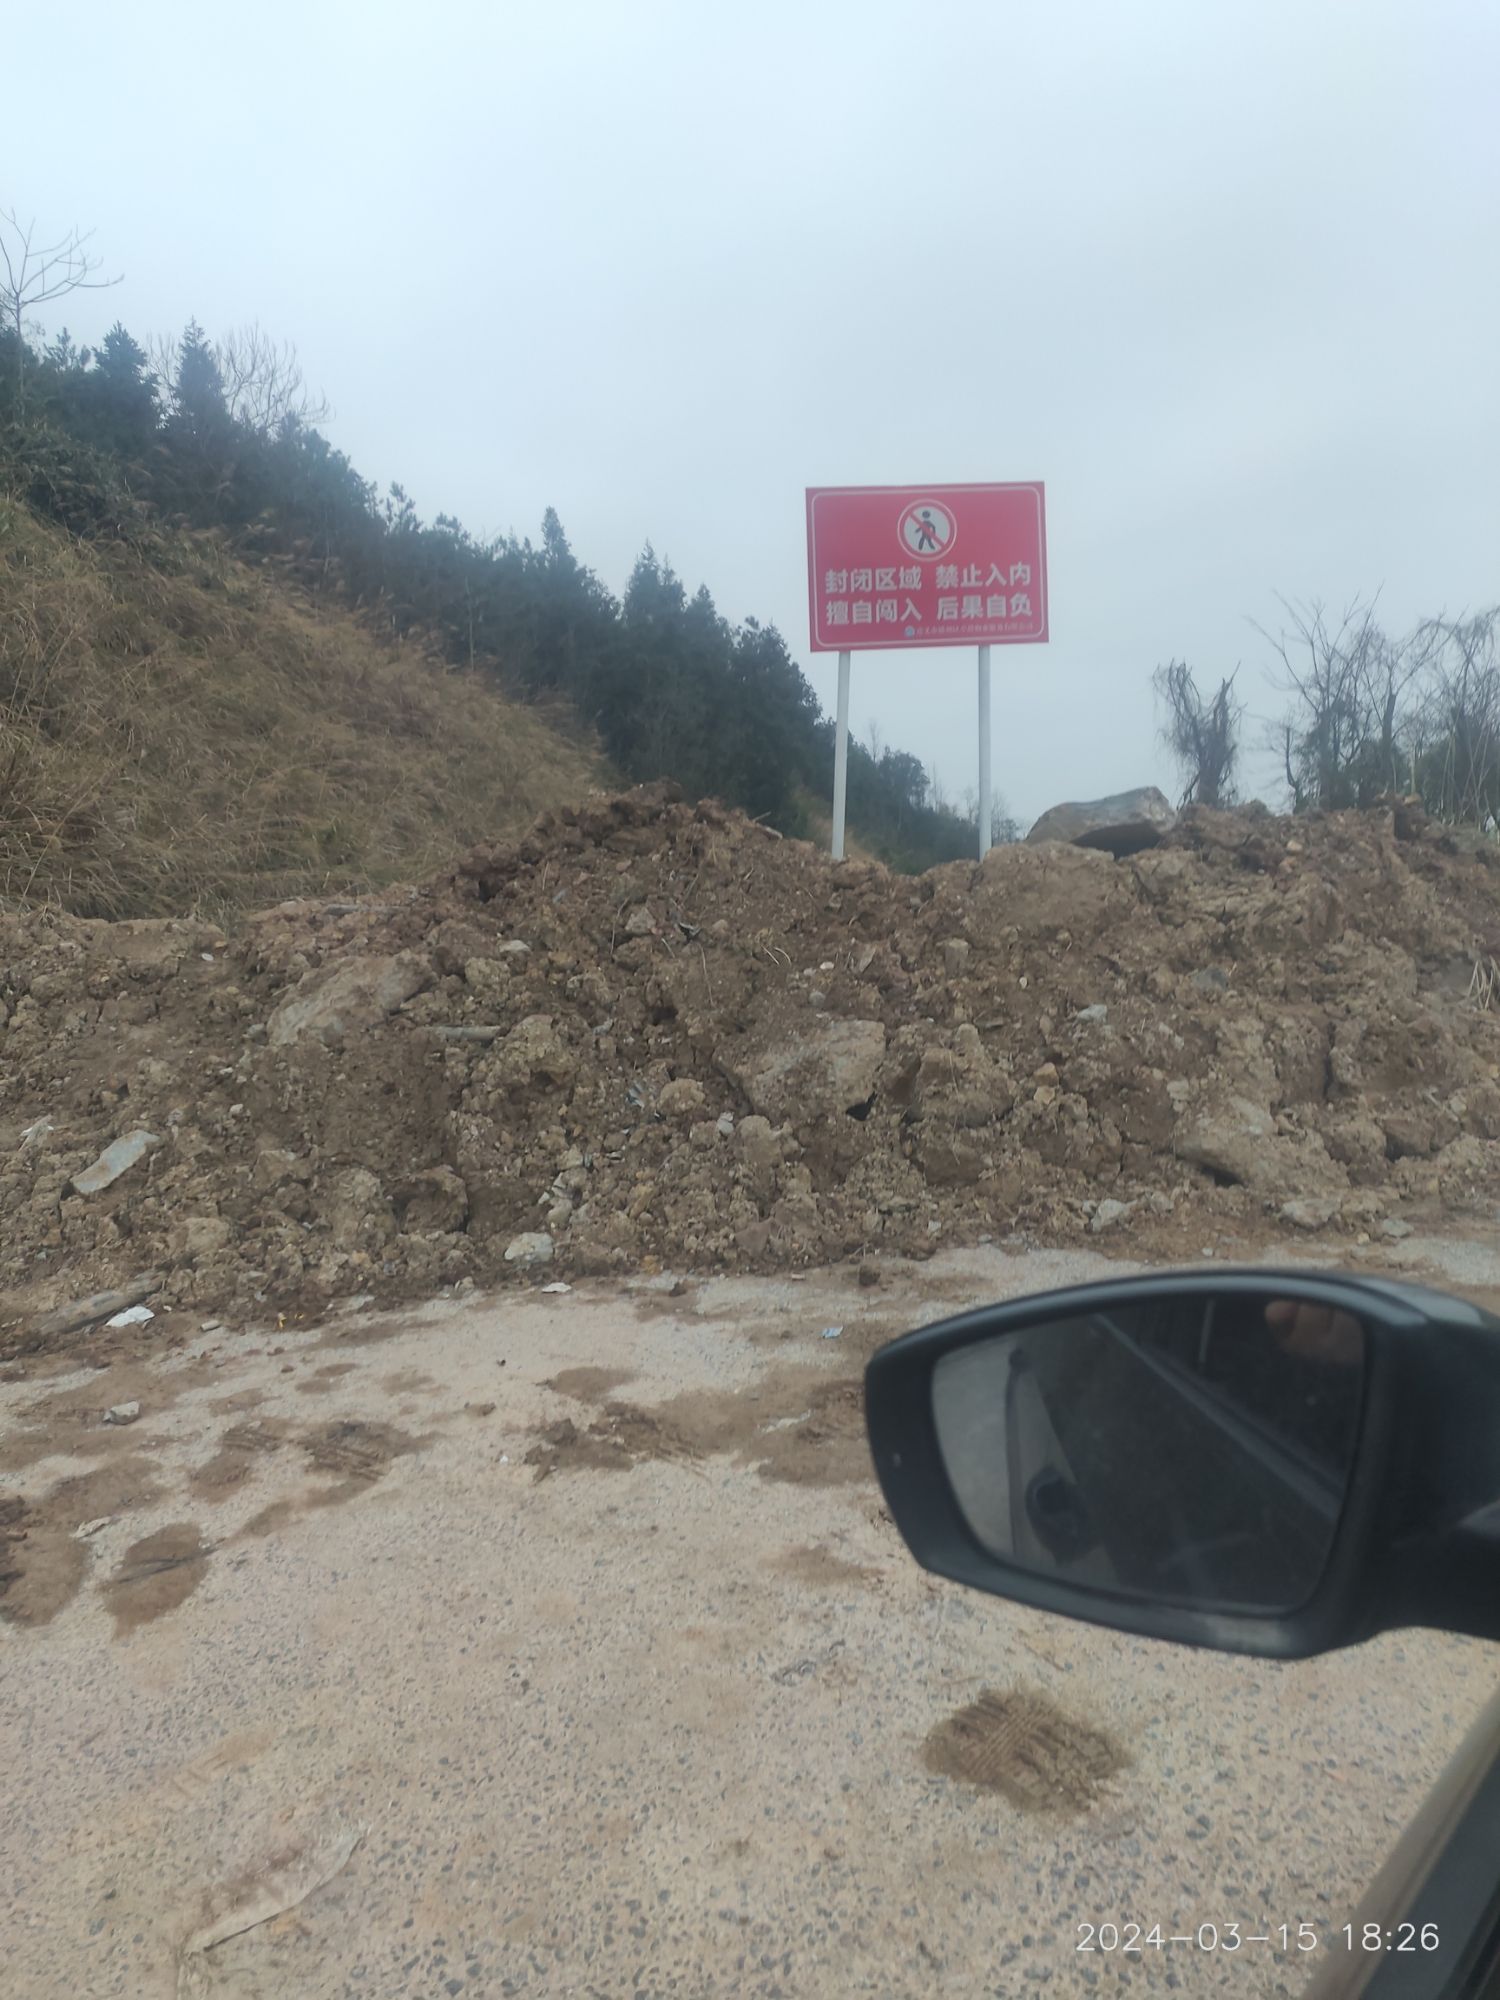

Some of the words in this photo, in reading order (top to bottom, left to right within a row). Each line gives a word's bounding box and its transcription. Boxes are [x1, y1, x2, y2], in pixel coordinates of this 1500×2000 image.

[826, 566, 922, 593] 封闭区域
[936, 562, 1031, 589] 禁止入内
[826, 598, 922, 625] 擅自闯入
[938, 593, 1032, 620] 后果自负
